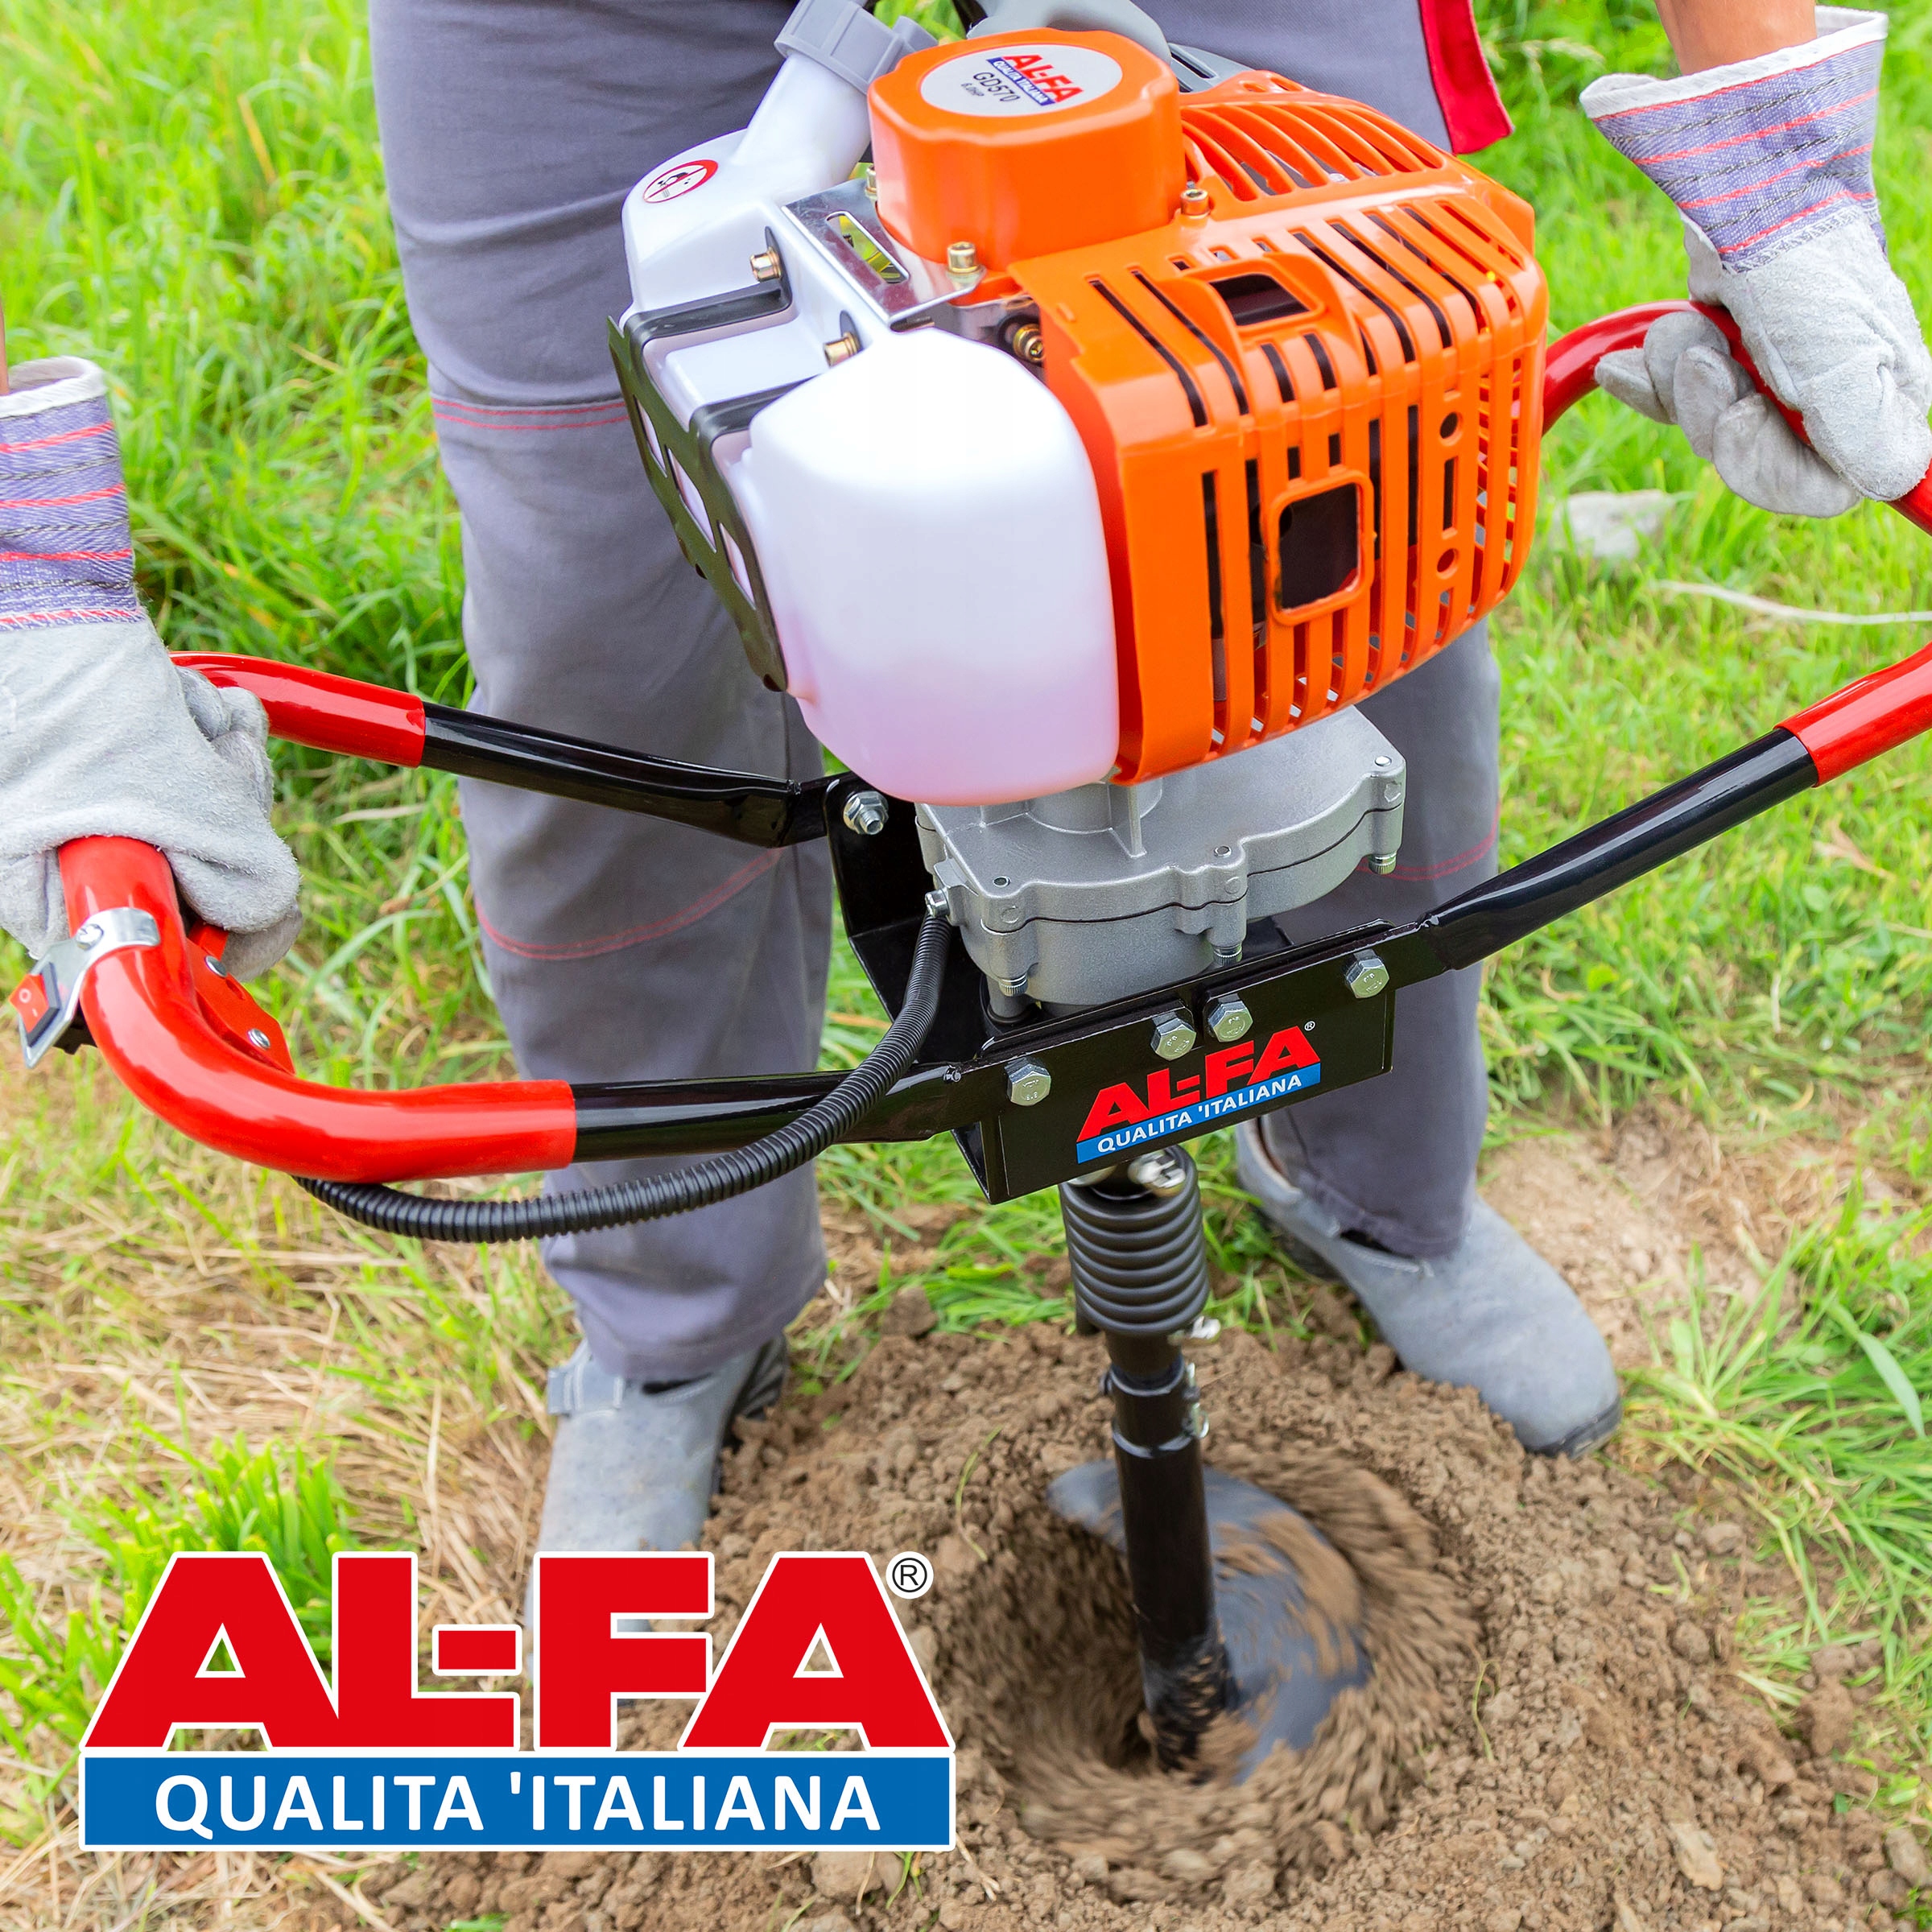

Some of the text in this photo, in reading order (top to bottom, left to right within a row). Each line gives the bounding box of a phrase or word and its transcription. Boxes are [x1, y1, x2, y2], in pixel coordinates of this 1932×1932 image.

[972, 72, 1021, 102] GD570
[1002, 55, 1084, 103] AL-FA
[1077, 1026, 1320, 1142] AL-FA
[1097, 1075, 1302, 1153] QUALITA 'ITALIANA
